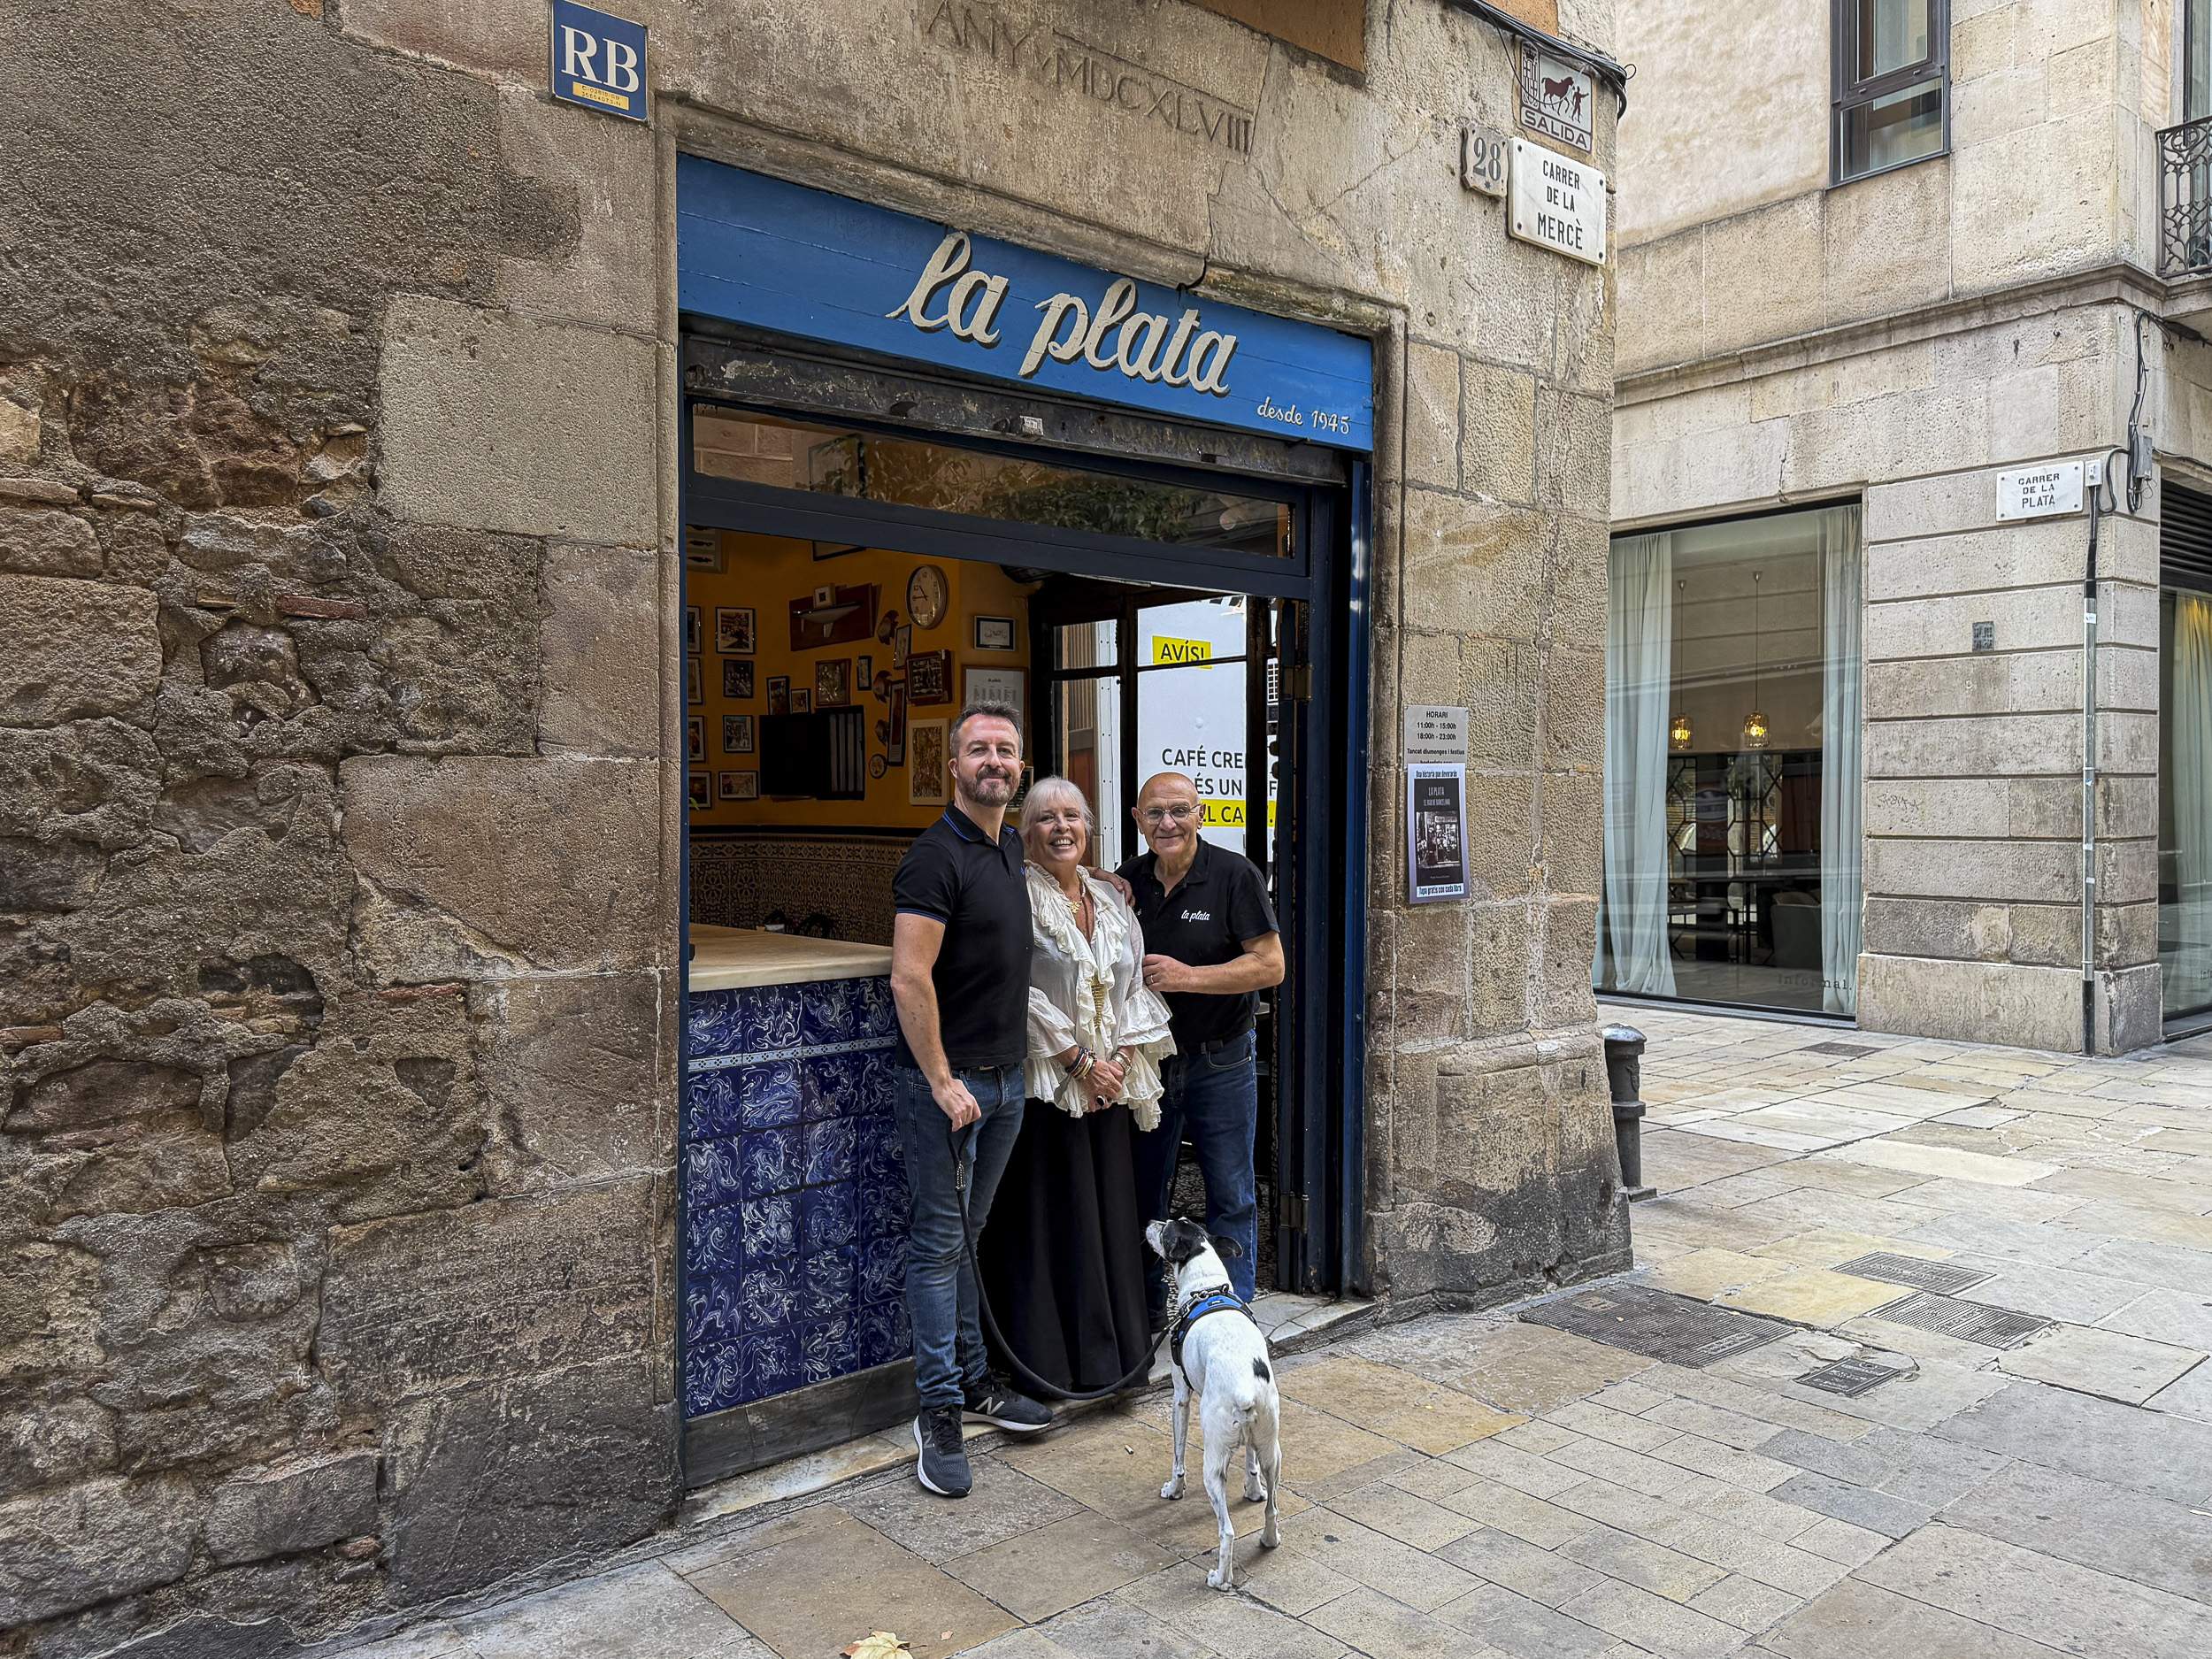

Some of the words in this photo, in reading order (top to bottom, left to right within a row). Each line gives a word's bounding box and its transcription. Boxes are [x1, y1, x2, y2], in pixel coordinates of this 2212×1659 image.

[926, 0, 1030, 68] ANY
[560, 25, 639, 93] RB
[1524, 111, 1588, 150] SALIDA
[1472, 137, 1502, 181] 28
[1542, 159, 1580, 190] CARRER
[1547, 186, 1559, 206] DE
[1563, 194, 1575, 212] LA
[1537, 211, 1583, 250] MERCÈ
[885, 231, 1010, 343] la
[1018, 277, 1237, 395] plata
[1256, 396, 1304, 426] desde
[1311, 410, 1350, 434] 1945
[2018, 472, 2060, 486] CARRER
[2041, 484, 2055, 493] LA
[2022, 495, 2055, 509] PLATA
[1162, 745, 1207, 767] CAFÉ
[1211, 750, 1244, 769] CRE
[1219, 779, 1242, 796] UN
[1181, 910, 1189, 919] la
[1188, 910, 1210, 922] plata
